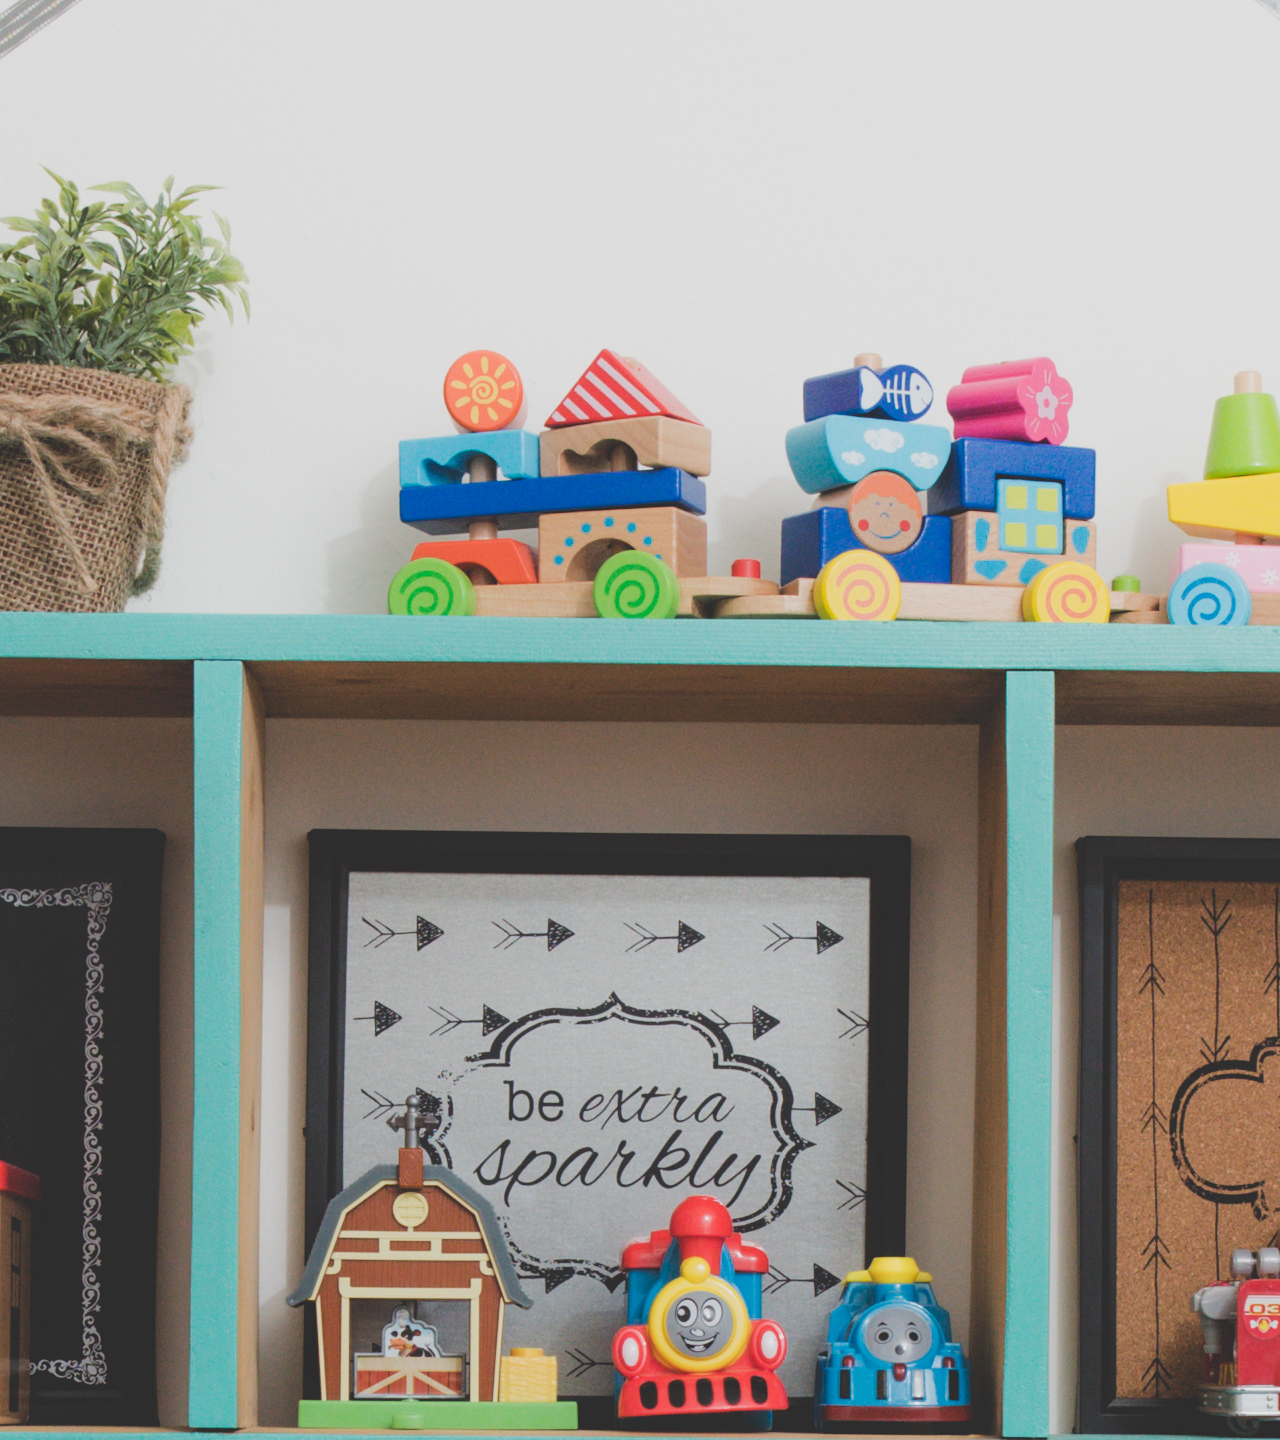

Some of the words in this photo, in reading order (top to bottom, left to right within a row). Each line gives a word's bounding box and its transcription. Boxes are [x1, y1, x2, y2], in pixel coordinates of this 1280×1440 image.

[503, 1080, 564, 1122] be
[579, 1085, 736, 1130] extra
[473, 1129, 762, 1208] sparkly
